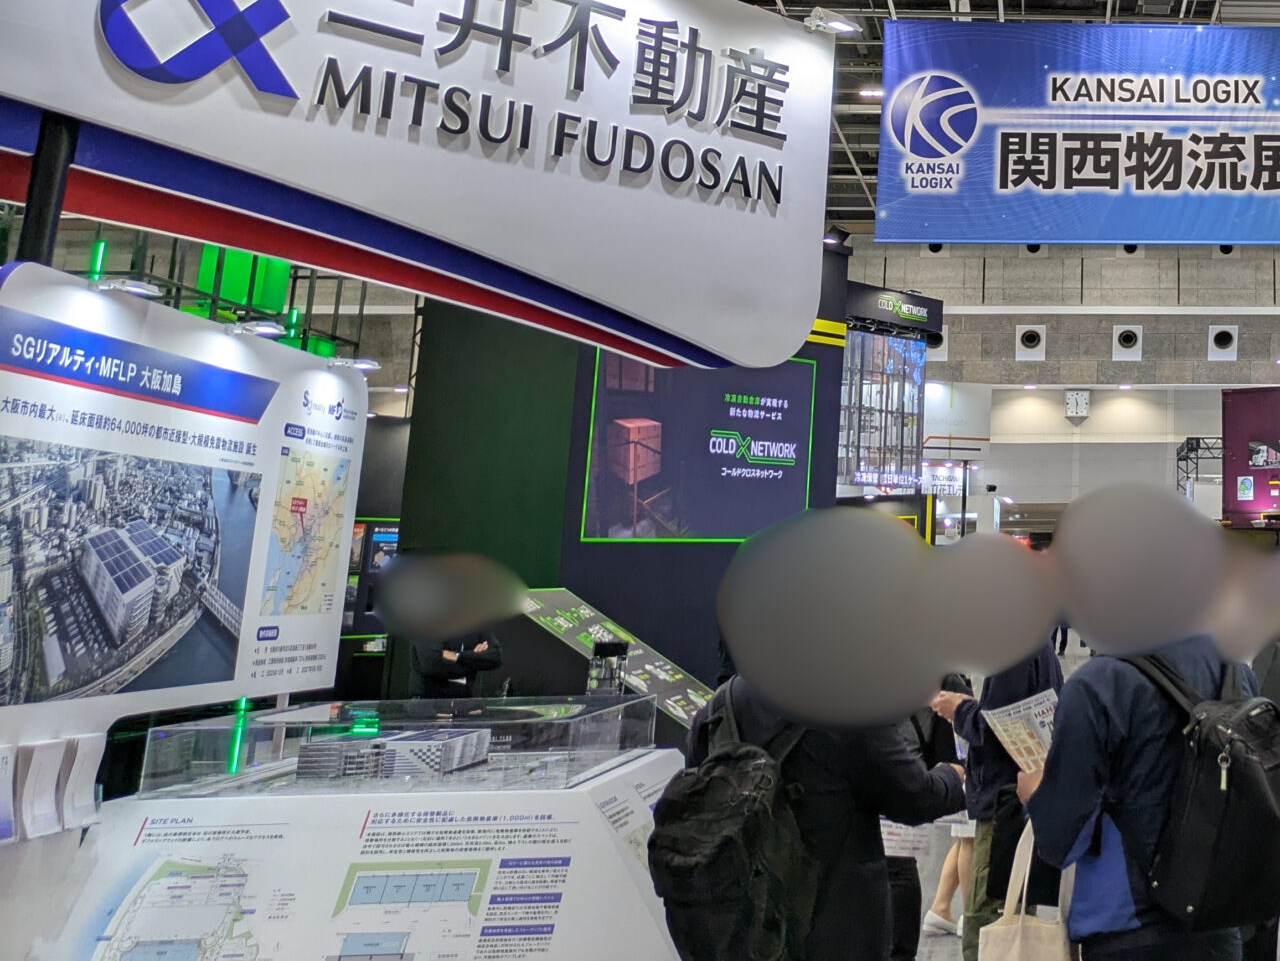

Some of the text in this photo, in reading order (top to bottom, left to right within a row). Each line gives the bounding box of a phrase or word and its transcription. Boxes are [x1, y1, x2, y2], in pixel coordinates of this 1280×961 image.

[1051, 77, 1262, 104] KANSAI LOGIX
[315, 57, 784, 204] MITSUI FUDOSAN
[905, 162, 960, 174] KANSAI
[911, 177, 953, 189] LOGIX
[879, 299, 893, 311] COLD
[901, 303, 928, 317] NETWORK
[140, 366, 182, 396] 大阪加島
[709, 437, 736, 455] COLD
[751, 440, 797, 459] NETWORK
[721, 467, 783, 479] コールドクロスネットワーク
